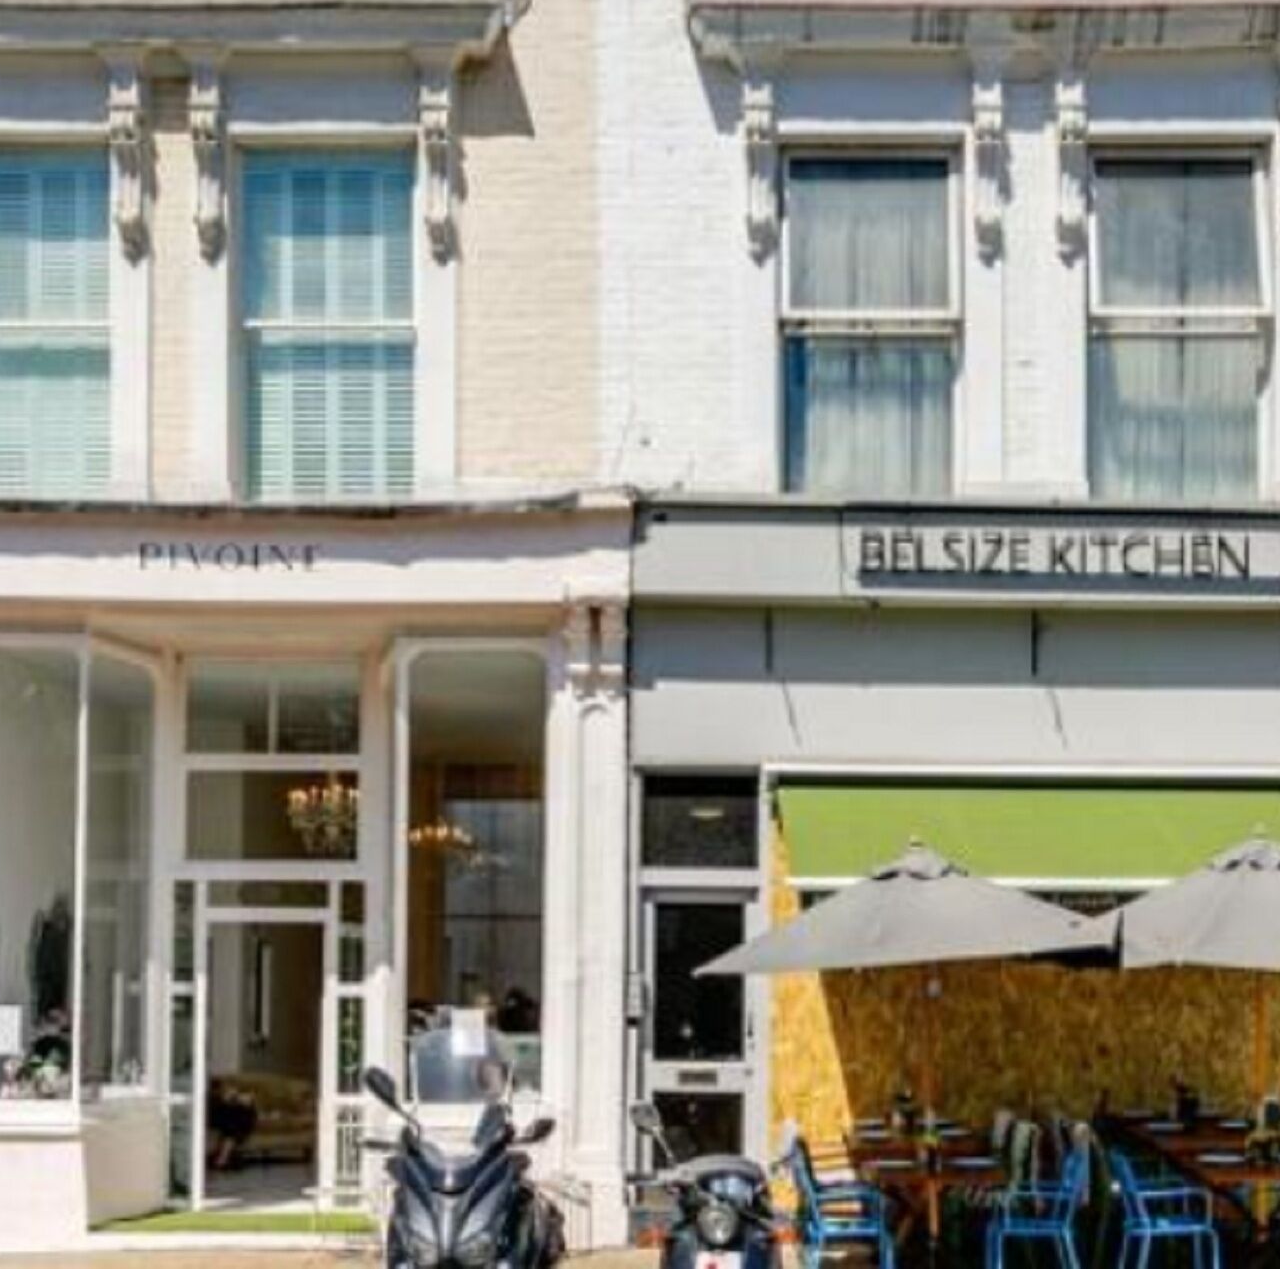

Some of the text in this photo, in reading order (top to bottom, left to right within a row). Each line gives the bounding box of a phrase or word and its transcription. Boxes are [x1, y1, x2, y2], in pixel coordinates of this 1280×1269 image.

[139, 542, 322, 572] PIVOINE
[860, 530, 1251, 579] BELSIZE KITCHEN
